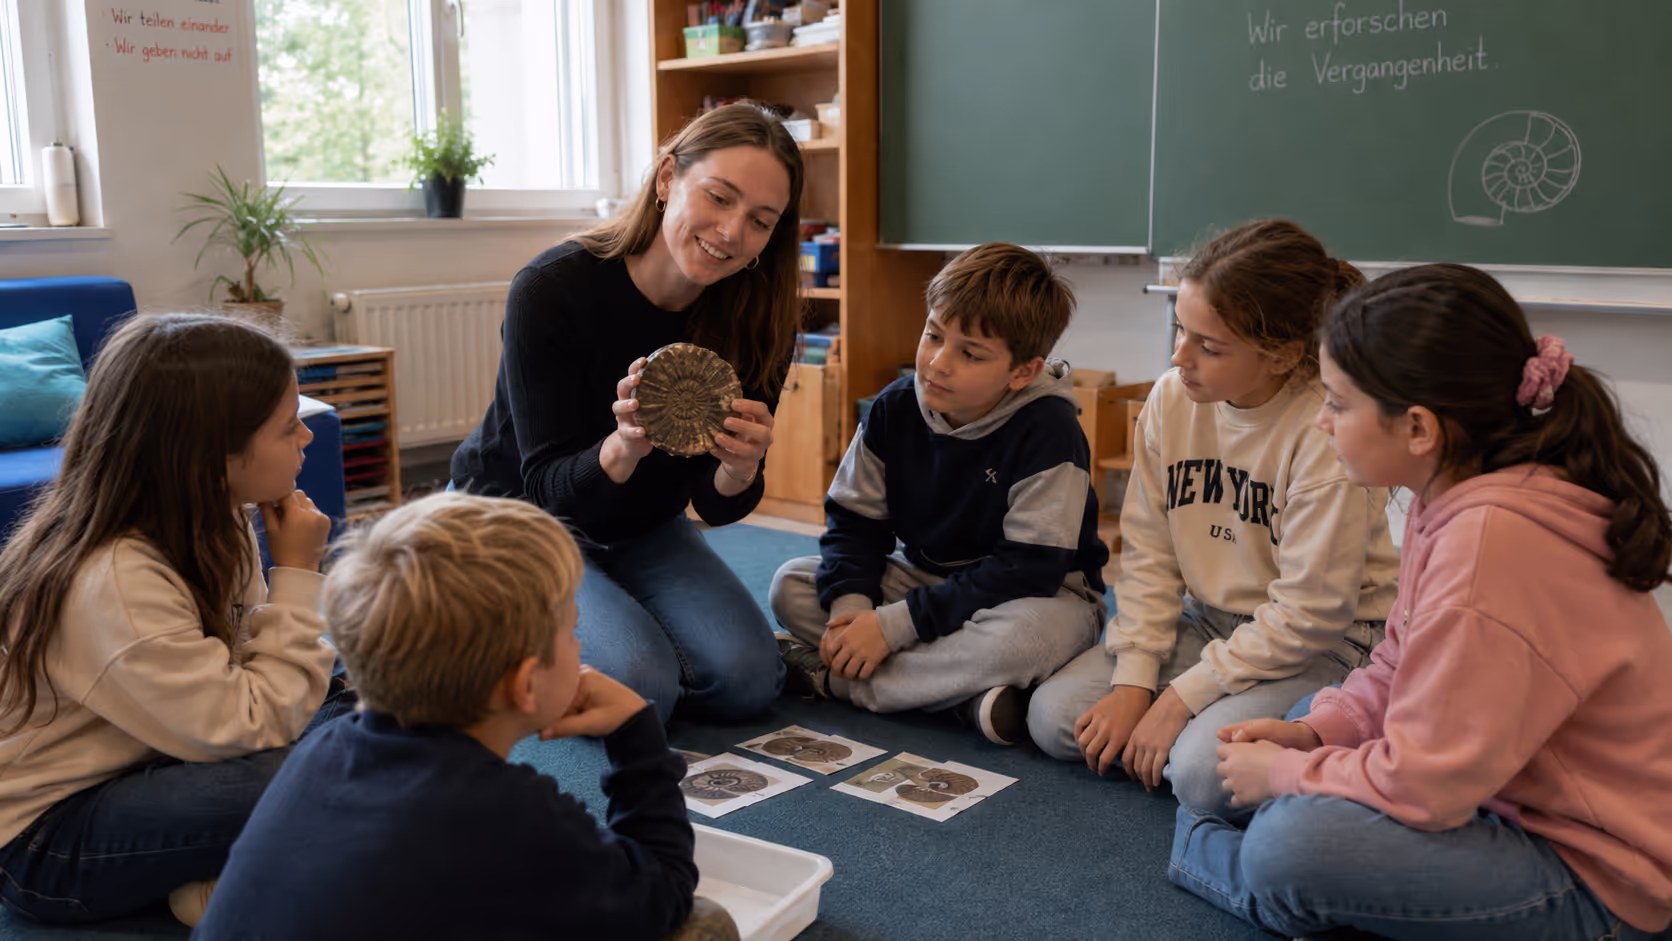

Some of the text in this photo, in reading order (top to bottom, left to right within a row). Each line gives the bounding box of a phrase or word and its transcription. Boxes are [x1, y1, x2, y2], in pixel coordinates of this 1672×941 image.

[111, 7, 230, 33] Wir teilen einander
[1248, 0, 1447, 46] Wir erforschen
[114, 36, 232, 63] Wir geben nicht auf
[1249, 57, 1288, 91] die
[1166, 459, 1223, 512] NEW
